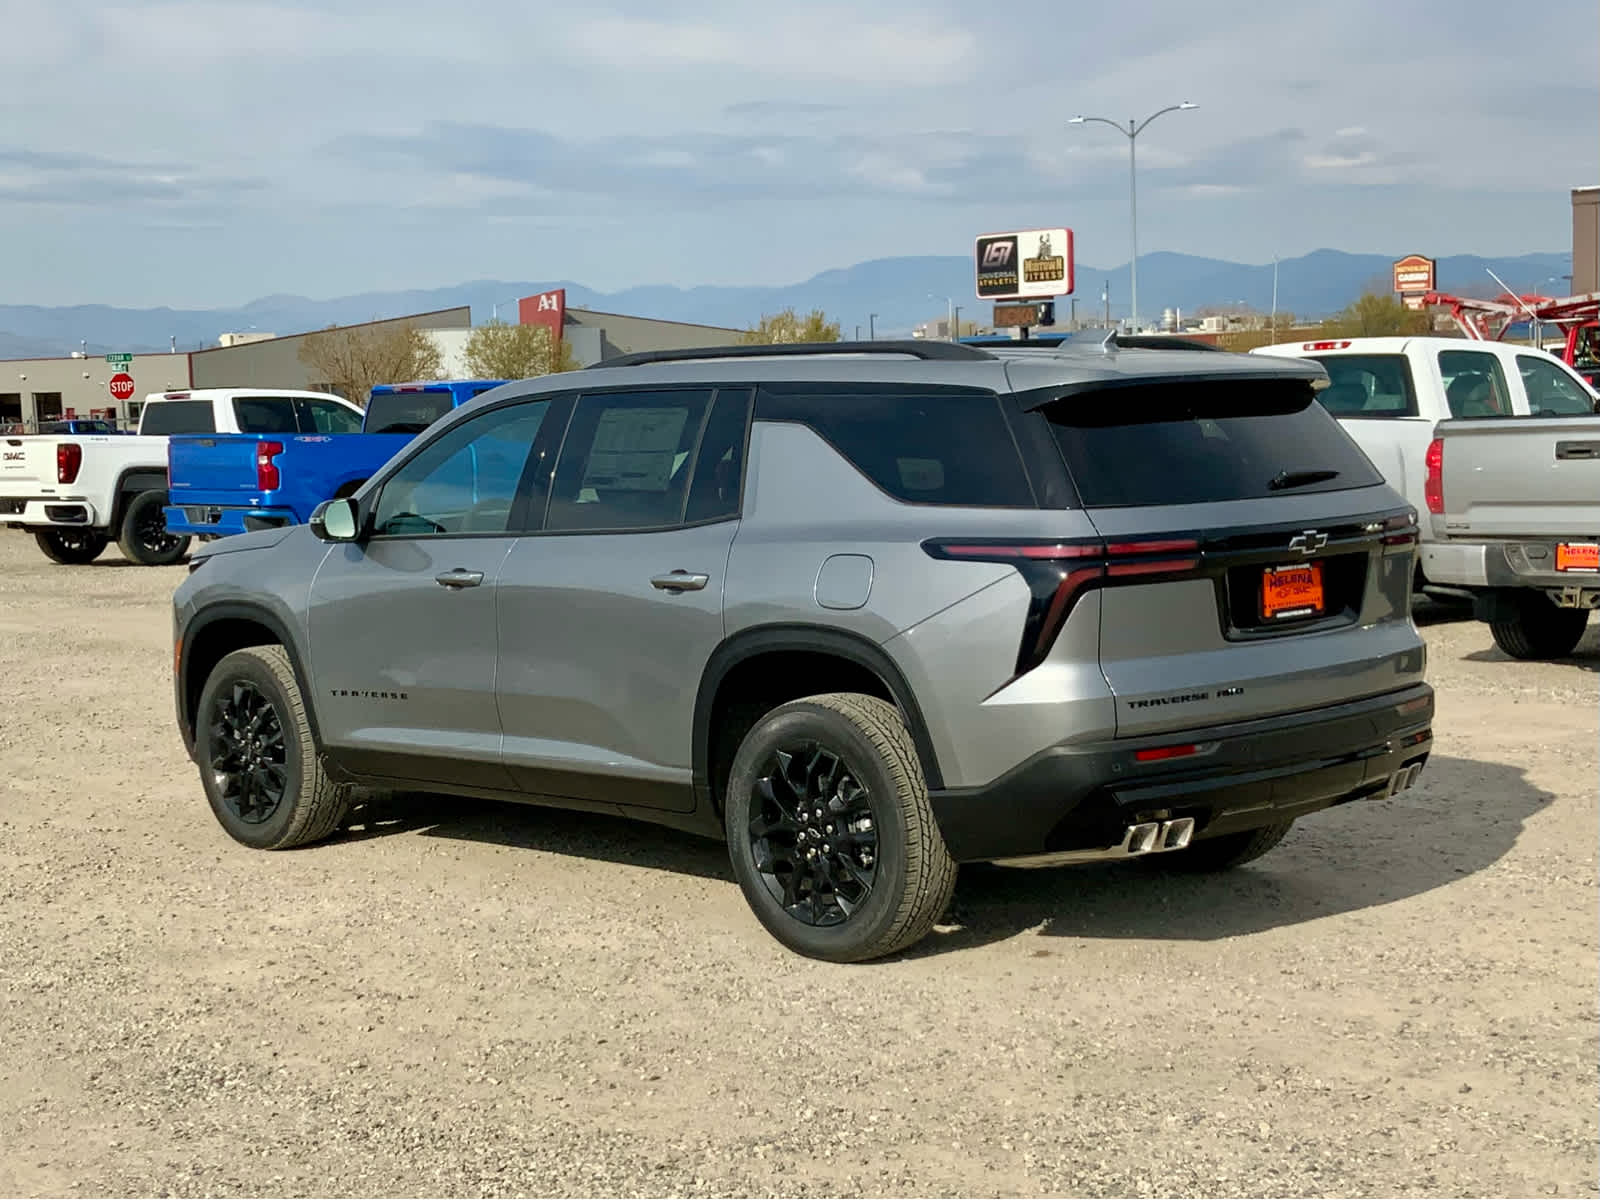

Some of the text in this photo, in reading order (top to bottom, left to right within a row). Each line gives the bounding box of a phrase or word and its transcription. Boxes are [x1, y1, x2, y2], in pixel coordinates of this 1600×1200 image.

[1025, 270, 1063, 281] FITNESS
[979, 277, 1018, 287] ATHLETIC
[111, 381, 133, 393] STOP
[3, 452, 26, 461] GMC
[1269, 573, 1313, 590] HELENA
[330, 689, 409, 700] TRAVERSE
[1127, 692, 1209, 709] TRAVERSE
